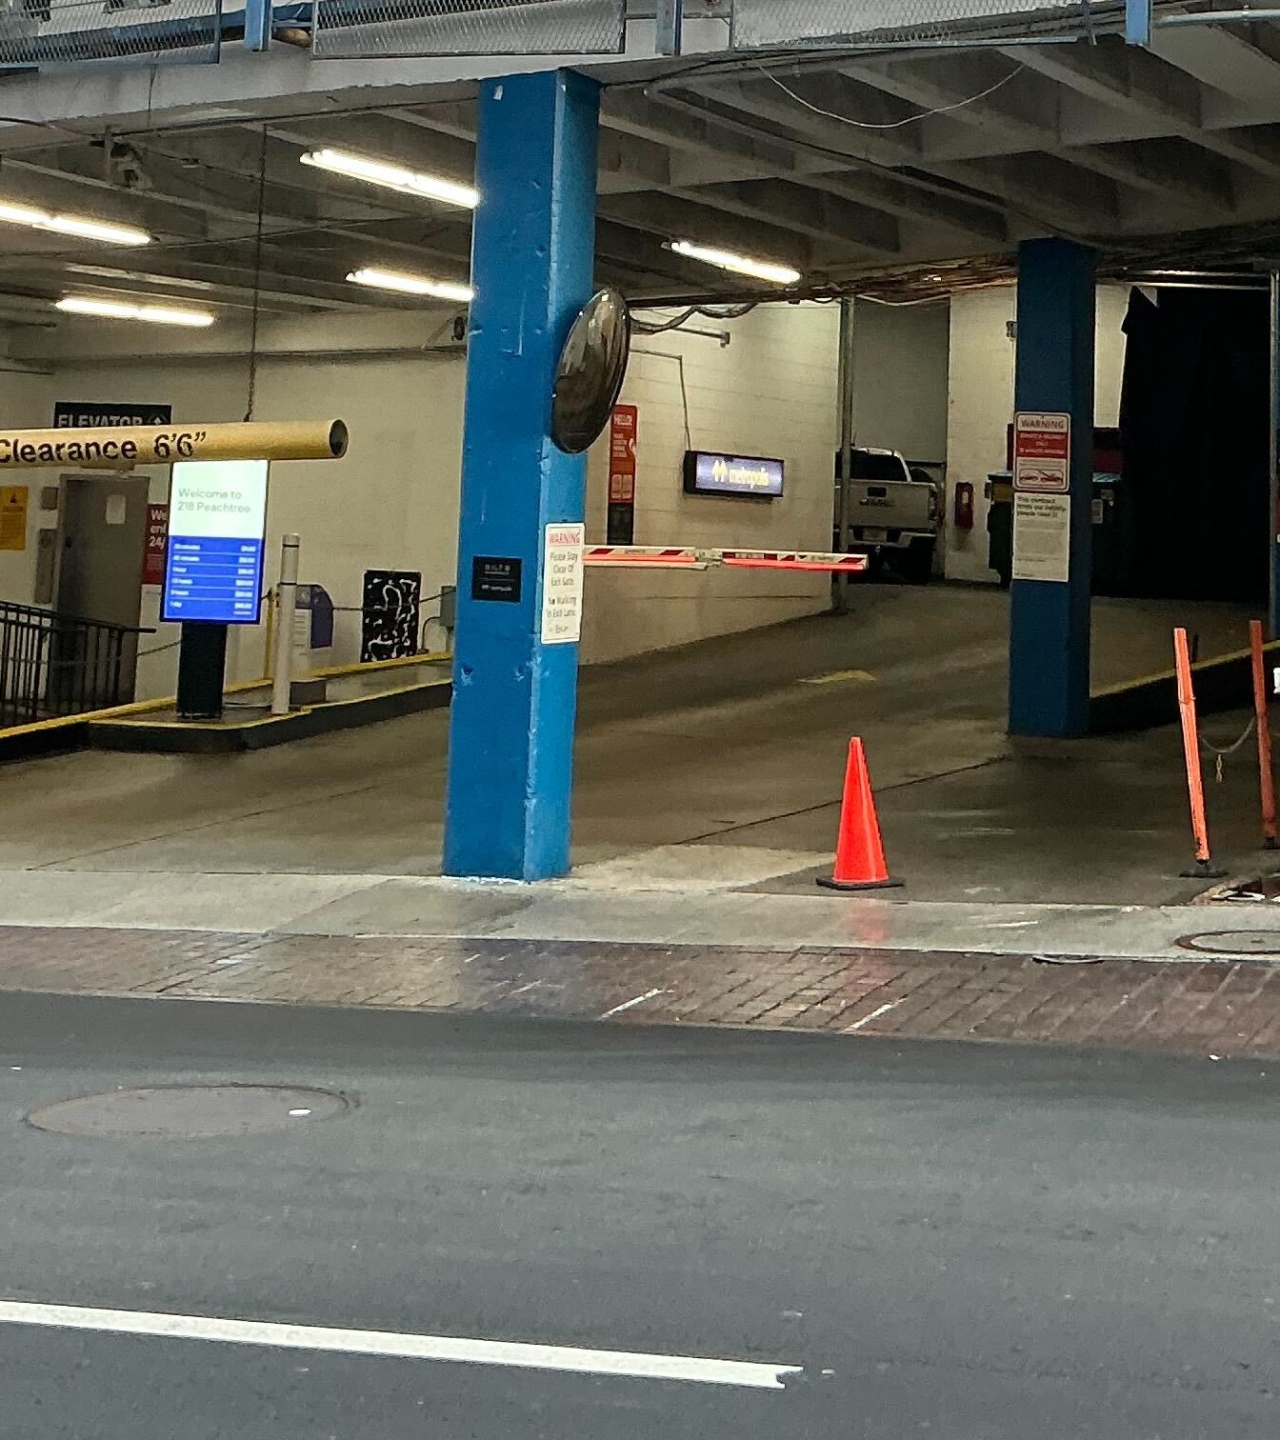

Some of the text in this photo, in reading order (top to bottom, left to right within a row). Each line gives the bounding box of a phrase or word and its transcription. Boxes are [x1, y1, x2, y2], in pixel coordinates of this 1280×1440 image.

[1021, 419, 1064, 429] WARNING
[178, 488, 242, 500] Welcome to
[177, 502, 251, 513] 218 Peachtree
